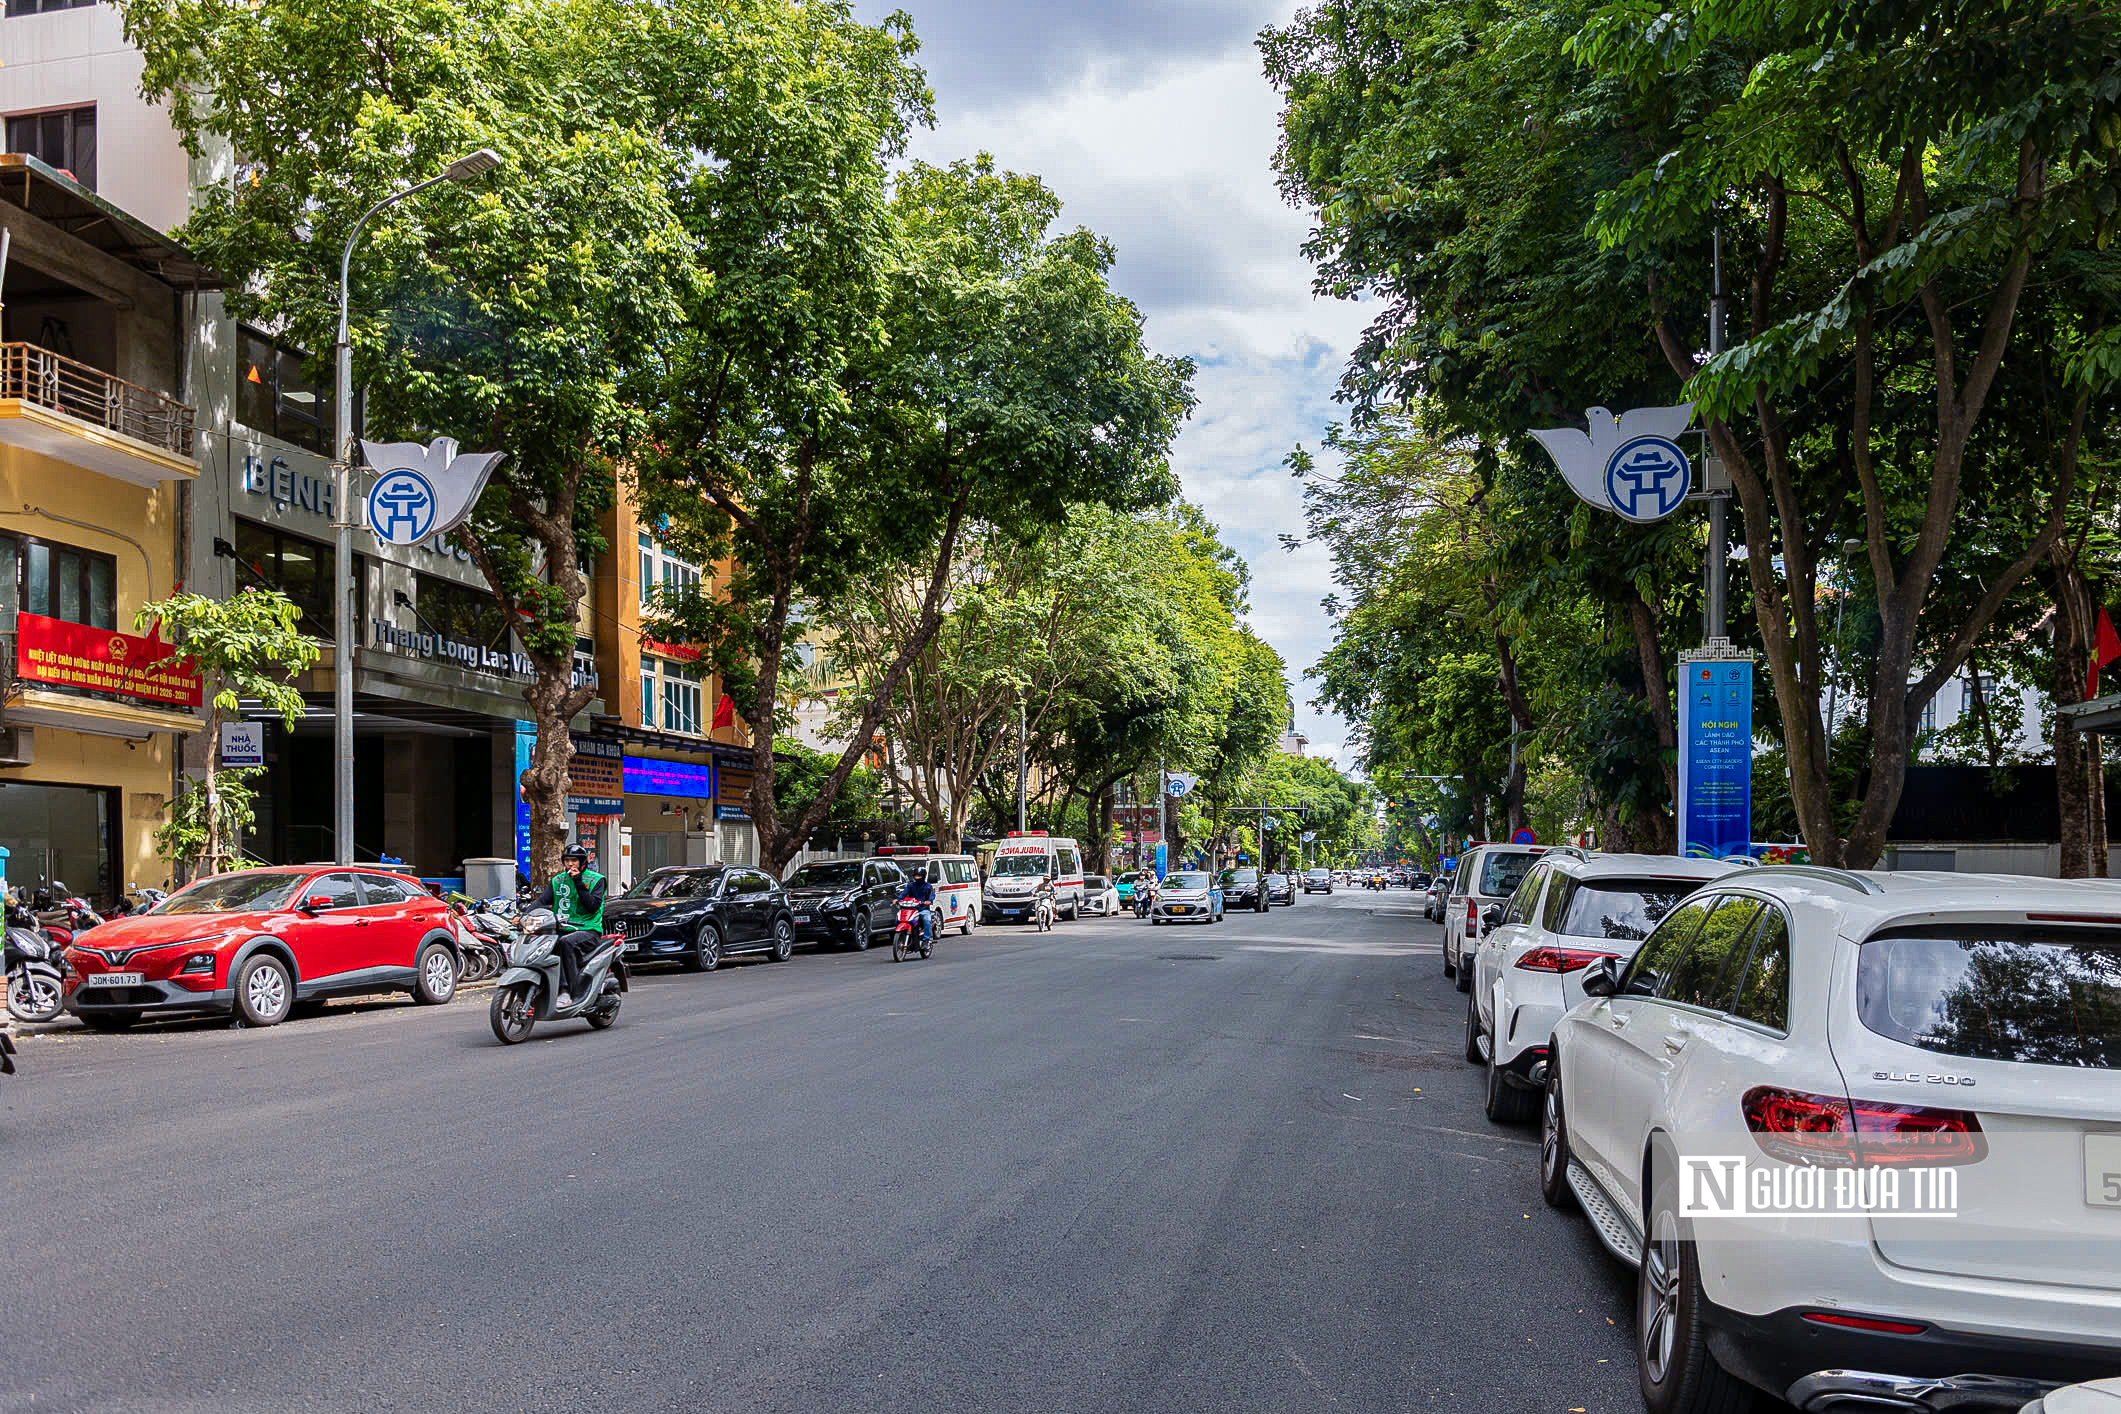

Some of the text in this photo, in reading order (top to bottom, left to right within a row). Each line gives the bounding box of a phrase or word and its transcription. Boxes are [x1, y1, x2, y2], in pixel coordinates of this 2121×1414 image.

[246, 455, 336, 518] BỆNH
[373, 618, 433, 656] Thang
[434, 634, 478, 668] Long
[482, 645, 508, 670] Lac
[510, 651, 538, 676] Vie
[45, 651, 57, 664] LIỆT
[91, 660, 104, 672] NGÀY
[160, 688, 172, 698] 2026
[1702, 720, 1716, 730] HỘI
[232, 733, 250, 742] NHÀ
[226, 742, 256, 752] THUỐC
[1872, 1072, 1976, 1086] GLC 200
